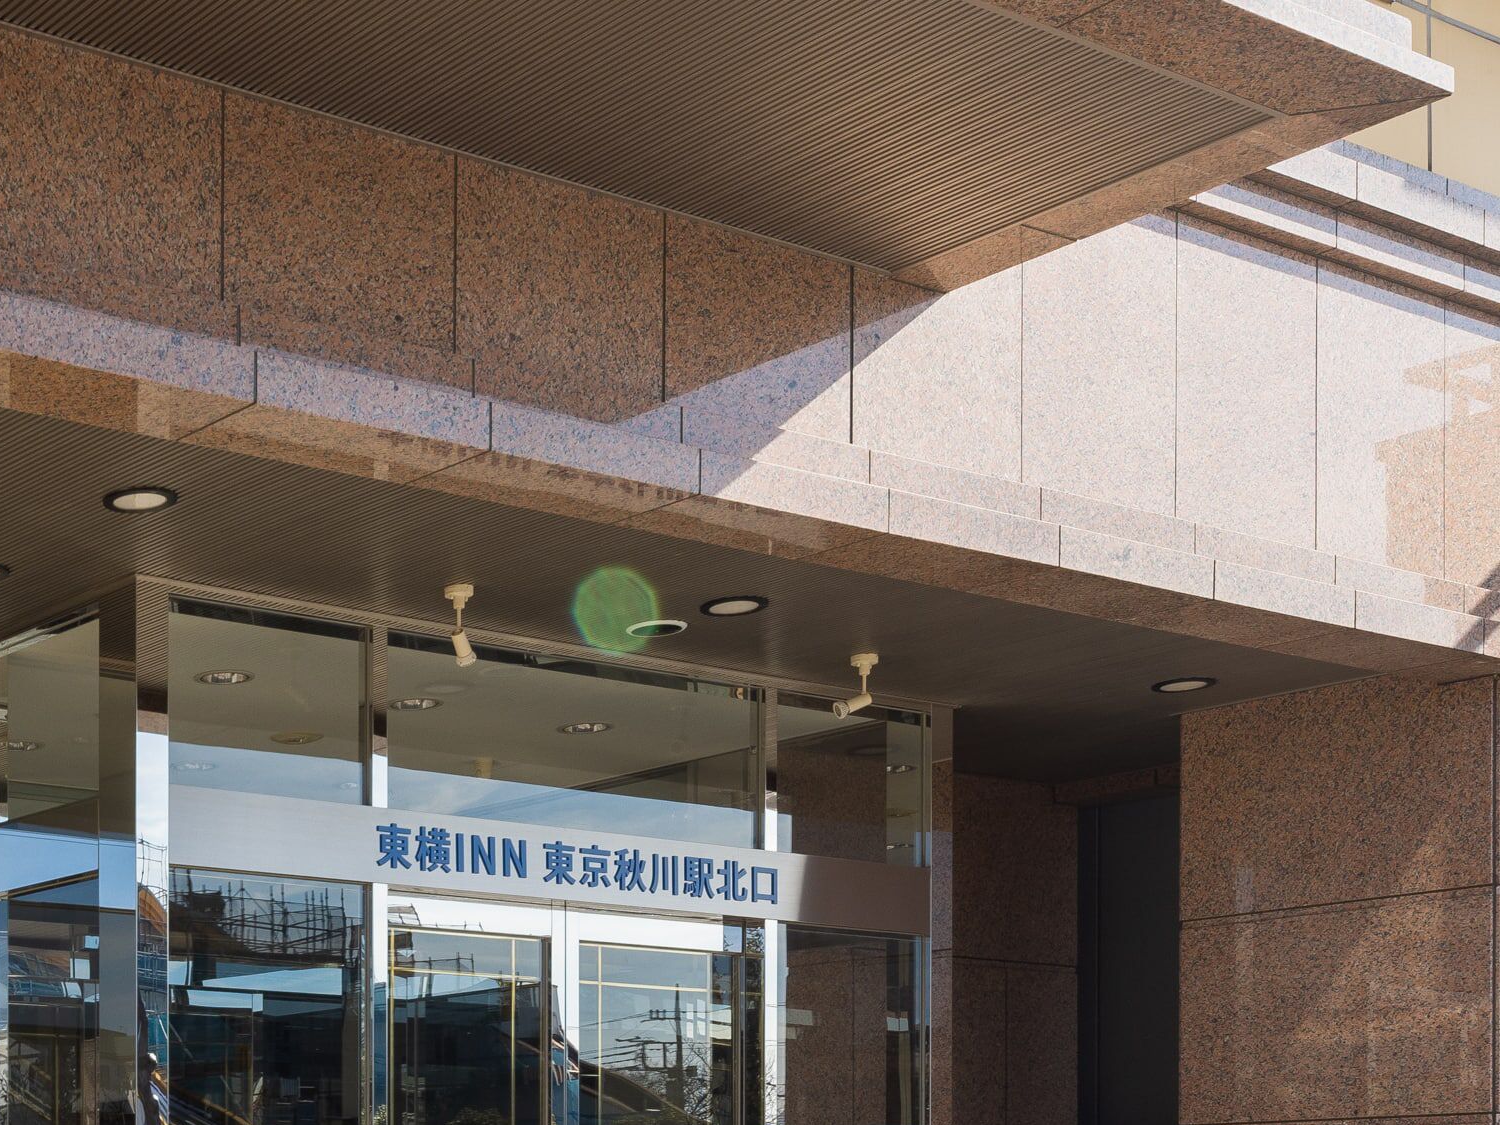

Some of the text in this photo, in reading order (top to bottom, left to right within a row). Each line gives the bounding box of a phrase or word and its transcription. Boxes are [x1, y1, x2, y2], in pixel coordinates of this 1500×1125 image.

[376, 823, 779, 905] 東横INN 東京秋川駅北口
